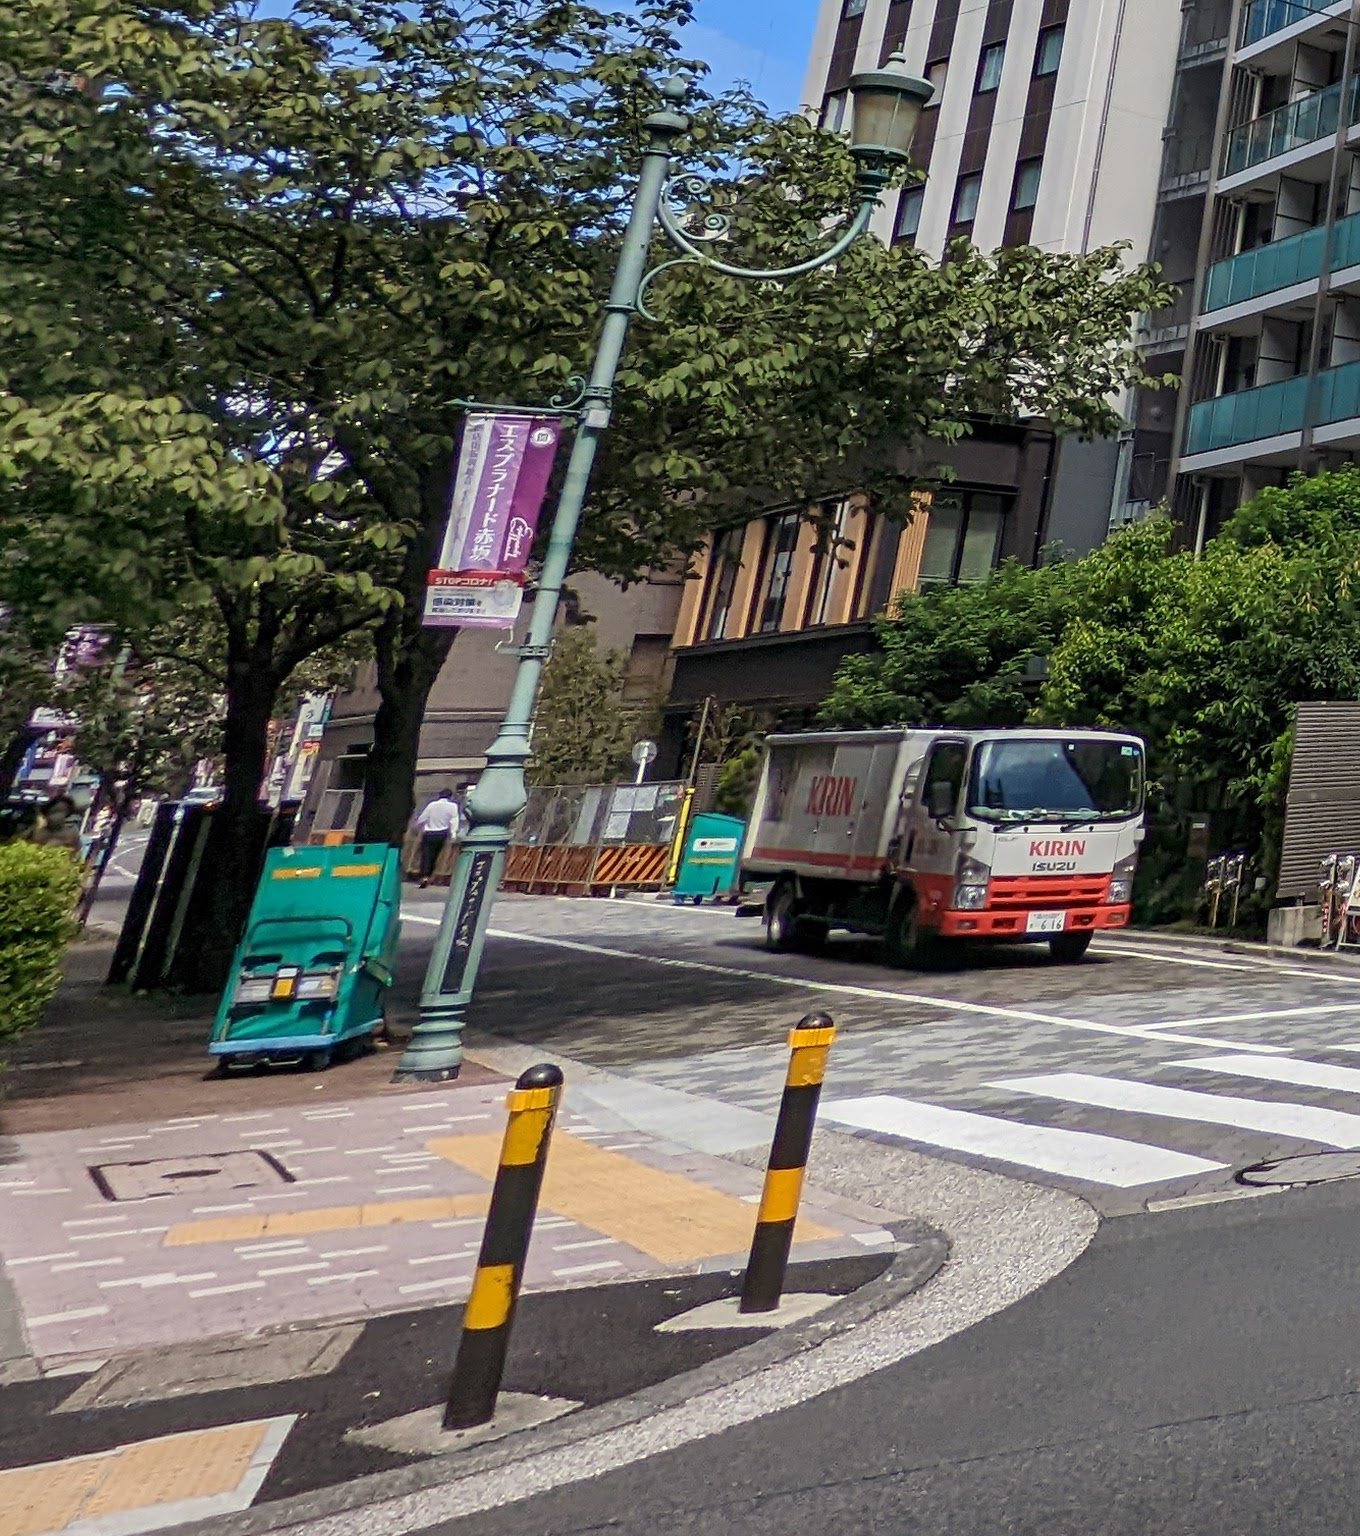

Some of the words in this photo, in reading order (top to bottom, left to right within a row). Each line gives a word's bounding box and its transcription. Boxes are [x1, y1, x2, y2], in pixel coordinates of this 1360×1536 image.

[470, 424, 519, 561] エスプラナード赤坂
[805, 775, 857, 816] KIRIN
[1029, 840, 1085, 856] KIRIN
[1032, 862, 1076, 871] ISUZU
